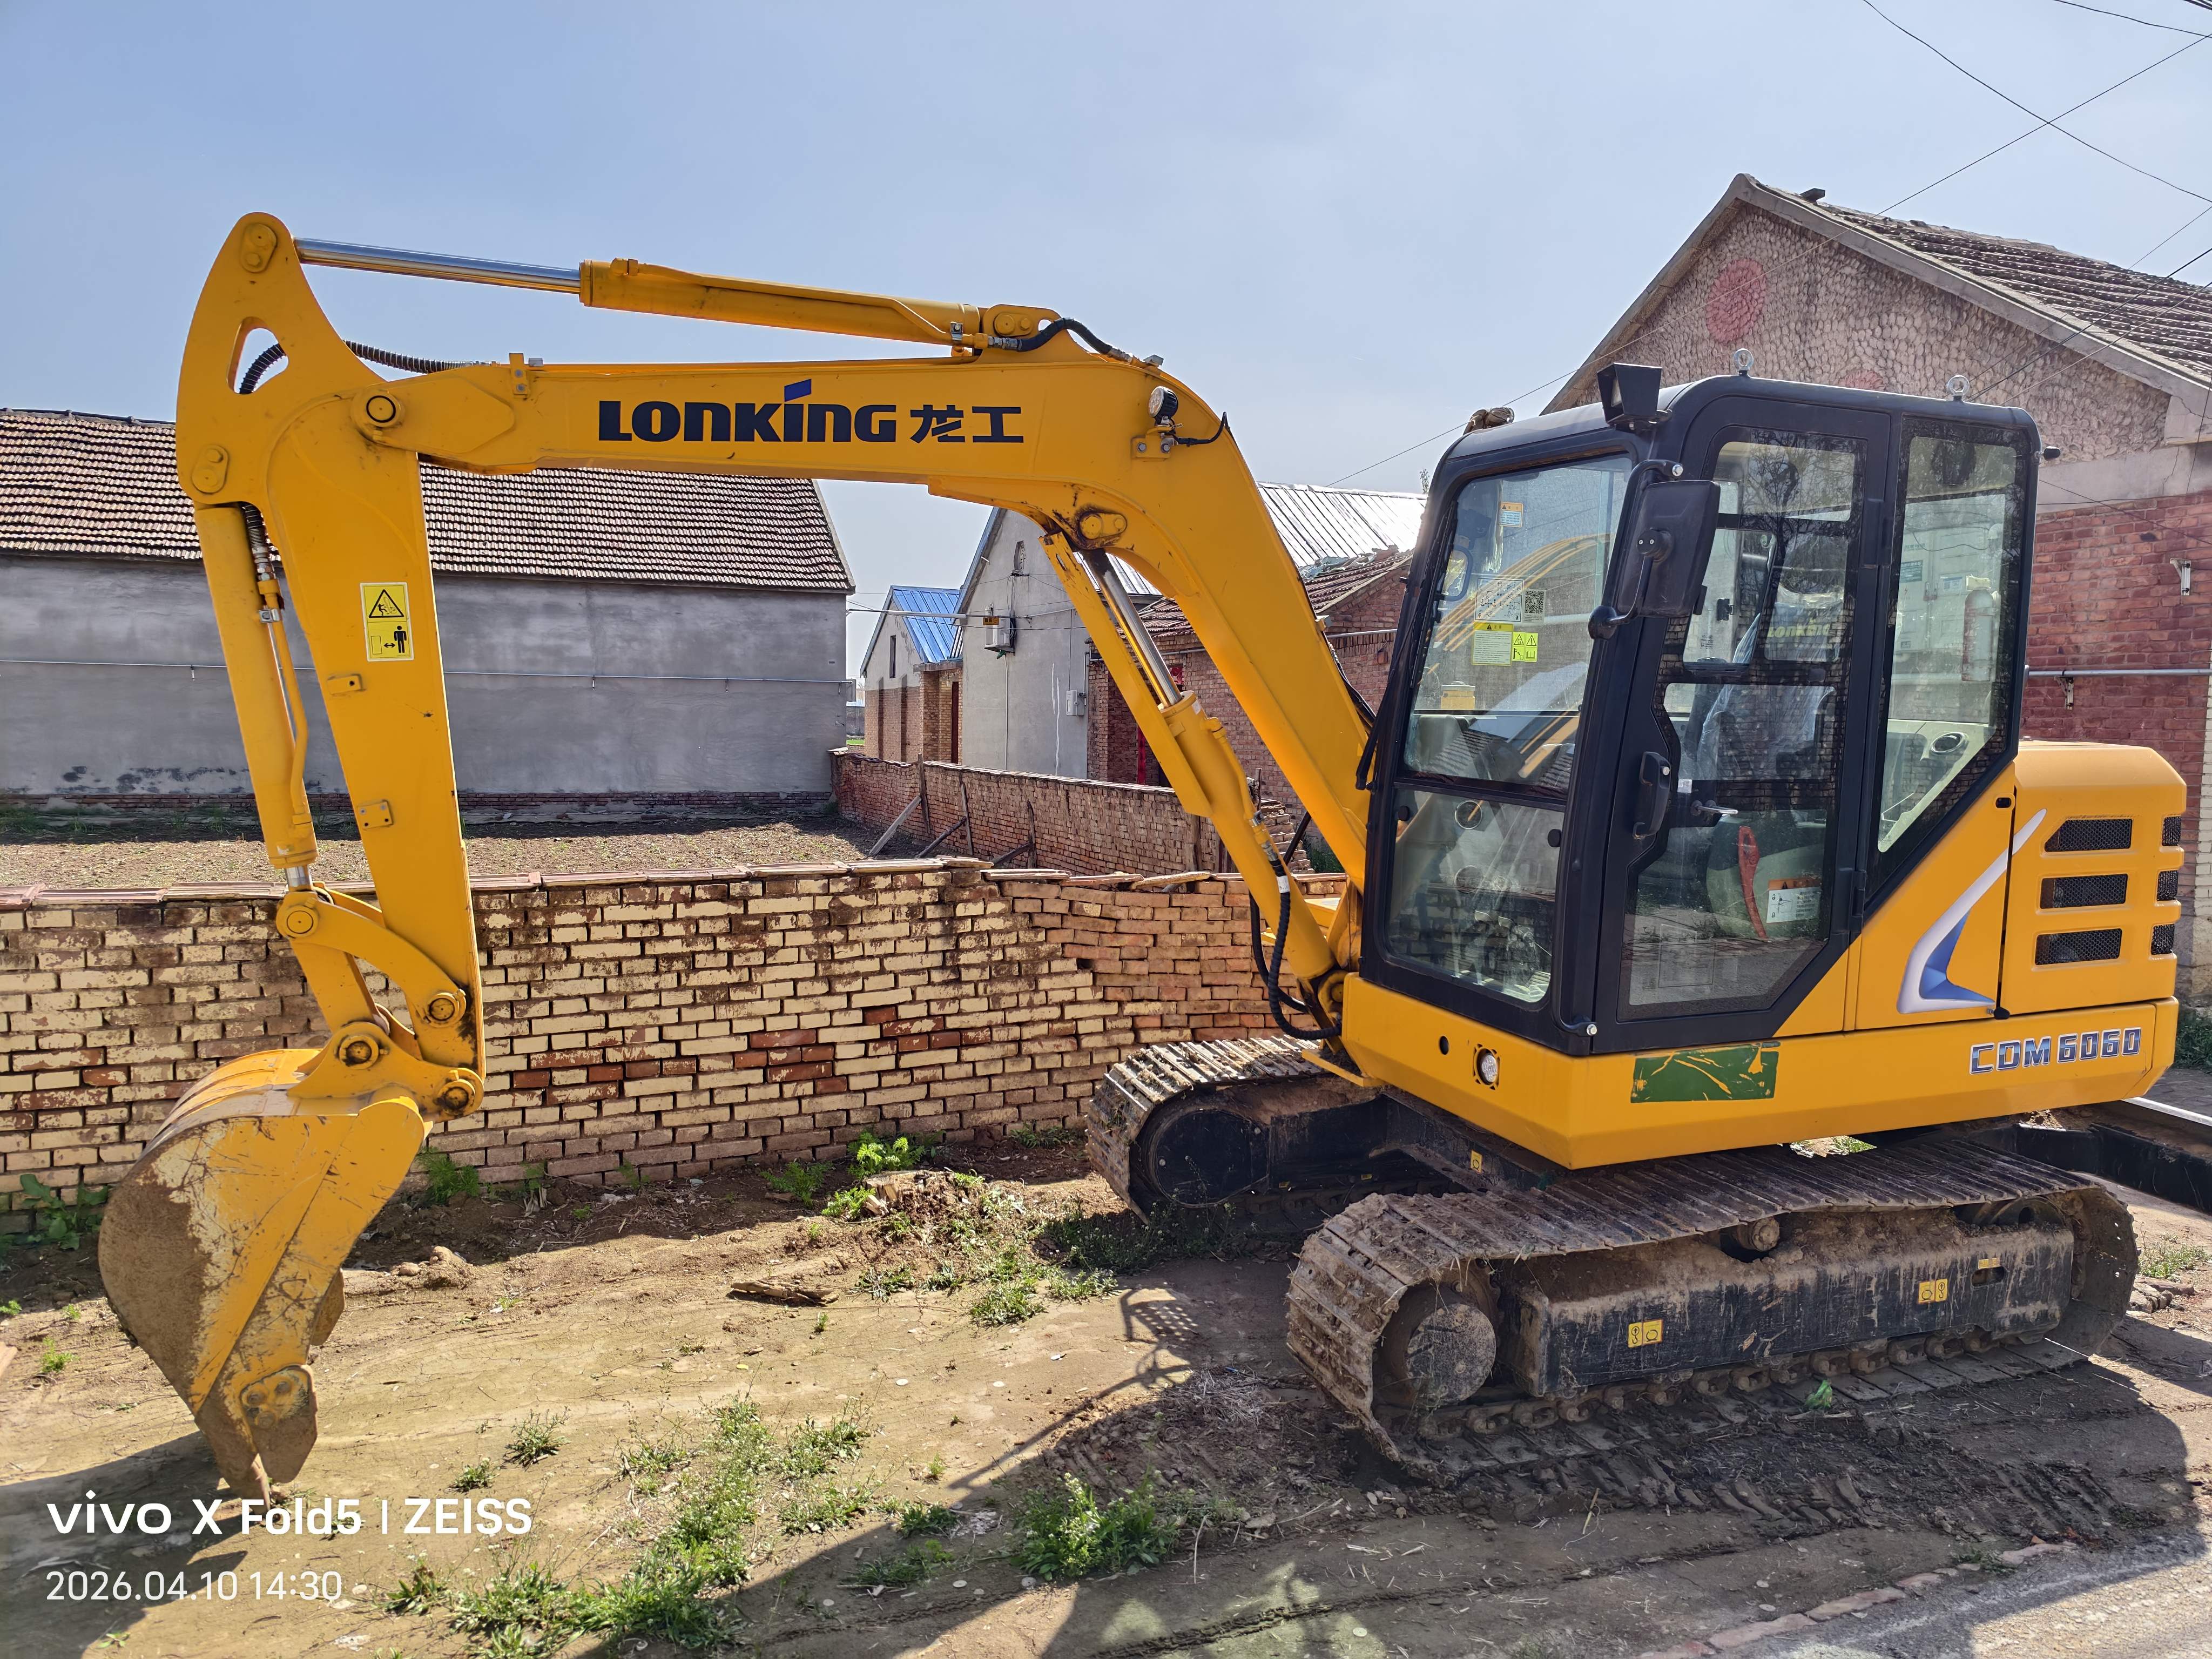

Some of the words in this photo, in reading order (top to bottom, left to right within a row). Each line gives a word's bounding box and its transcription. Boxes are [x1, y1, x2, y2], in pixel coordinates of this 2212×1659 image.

[911, 404, 1024, 443] 龙工
[1970, 1036, 2052, 1075] CDM
[2057, 1028, 2142, 1063] 6060
